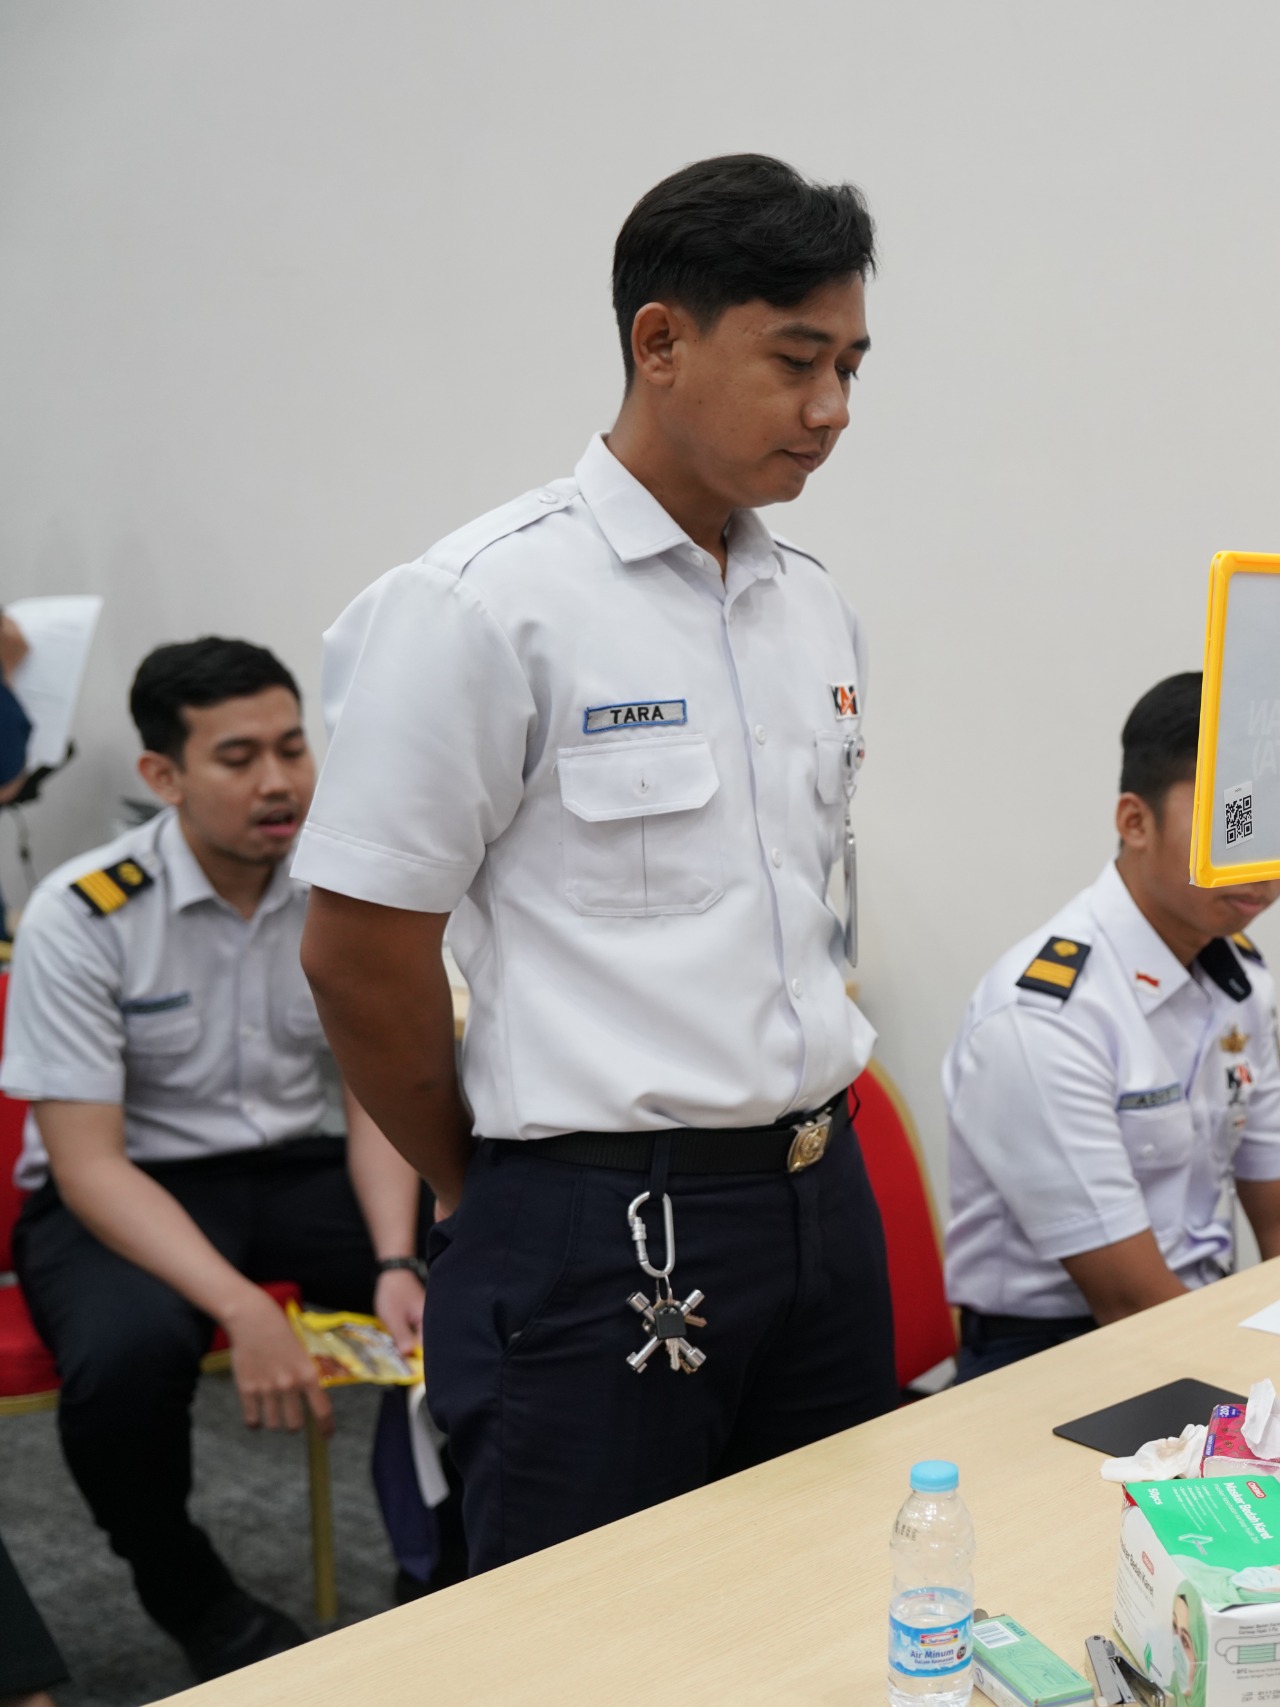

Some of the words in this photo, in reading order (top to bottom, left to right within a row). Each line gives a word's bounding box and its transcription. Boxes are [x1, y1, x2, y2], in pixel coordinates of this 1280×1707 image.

[610, 705, 664, 725] TARA
[1147, 1487, 1163, 1506] 50pcs
[1224, 1482, 1245, 1505] Masker
[1238, 1502, 1258, 1525] Bedah
[1252, 1521, 1274, 1540] Karet
[910, 1651, 923, 1659] Air
[924, 1649, 954, 1659] Minum
